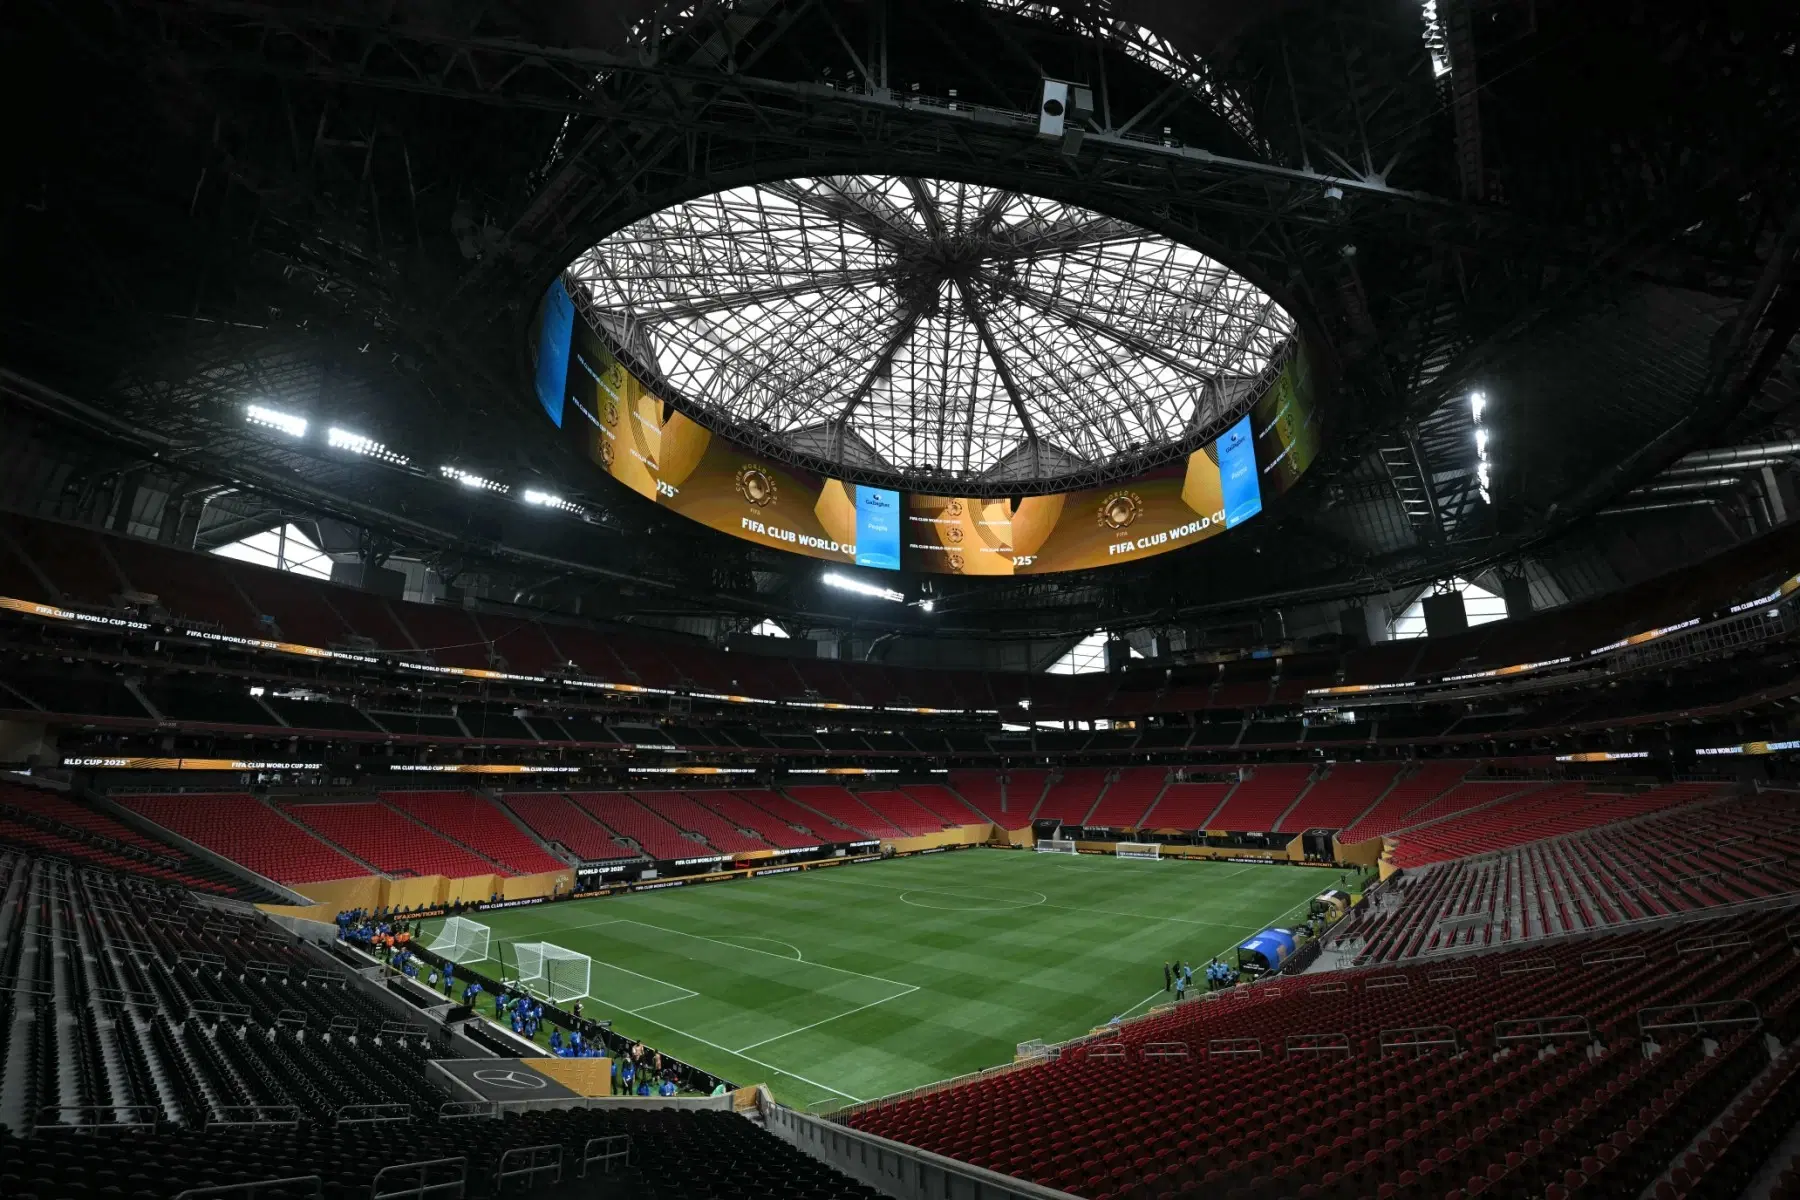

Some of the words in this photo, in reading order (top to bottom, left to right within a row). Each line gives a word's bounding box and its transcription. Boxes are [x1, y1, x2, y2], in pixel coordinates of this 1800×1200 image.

[742, 518, 765, 534] FIFA
[768, 526, 796, 542] CLUB
[798, 534, 839, 551] WORLD
[1109, 541, 1135, 555] FIFA
[1137, 532, 1168, 549] CLUB
[1169, 517, 1210, 540] WORLD
[36, 606, 53, 615] FIFA
[54, 610, 75, 619] CLUB
[76, 613, 108, 624] WORLD
[222, 635, 246, 644] WORLD
[578, 867, 598, 876] WORLD
